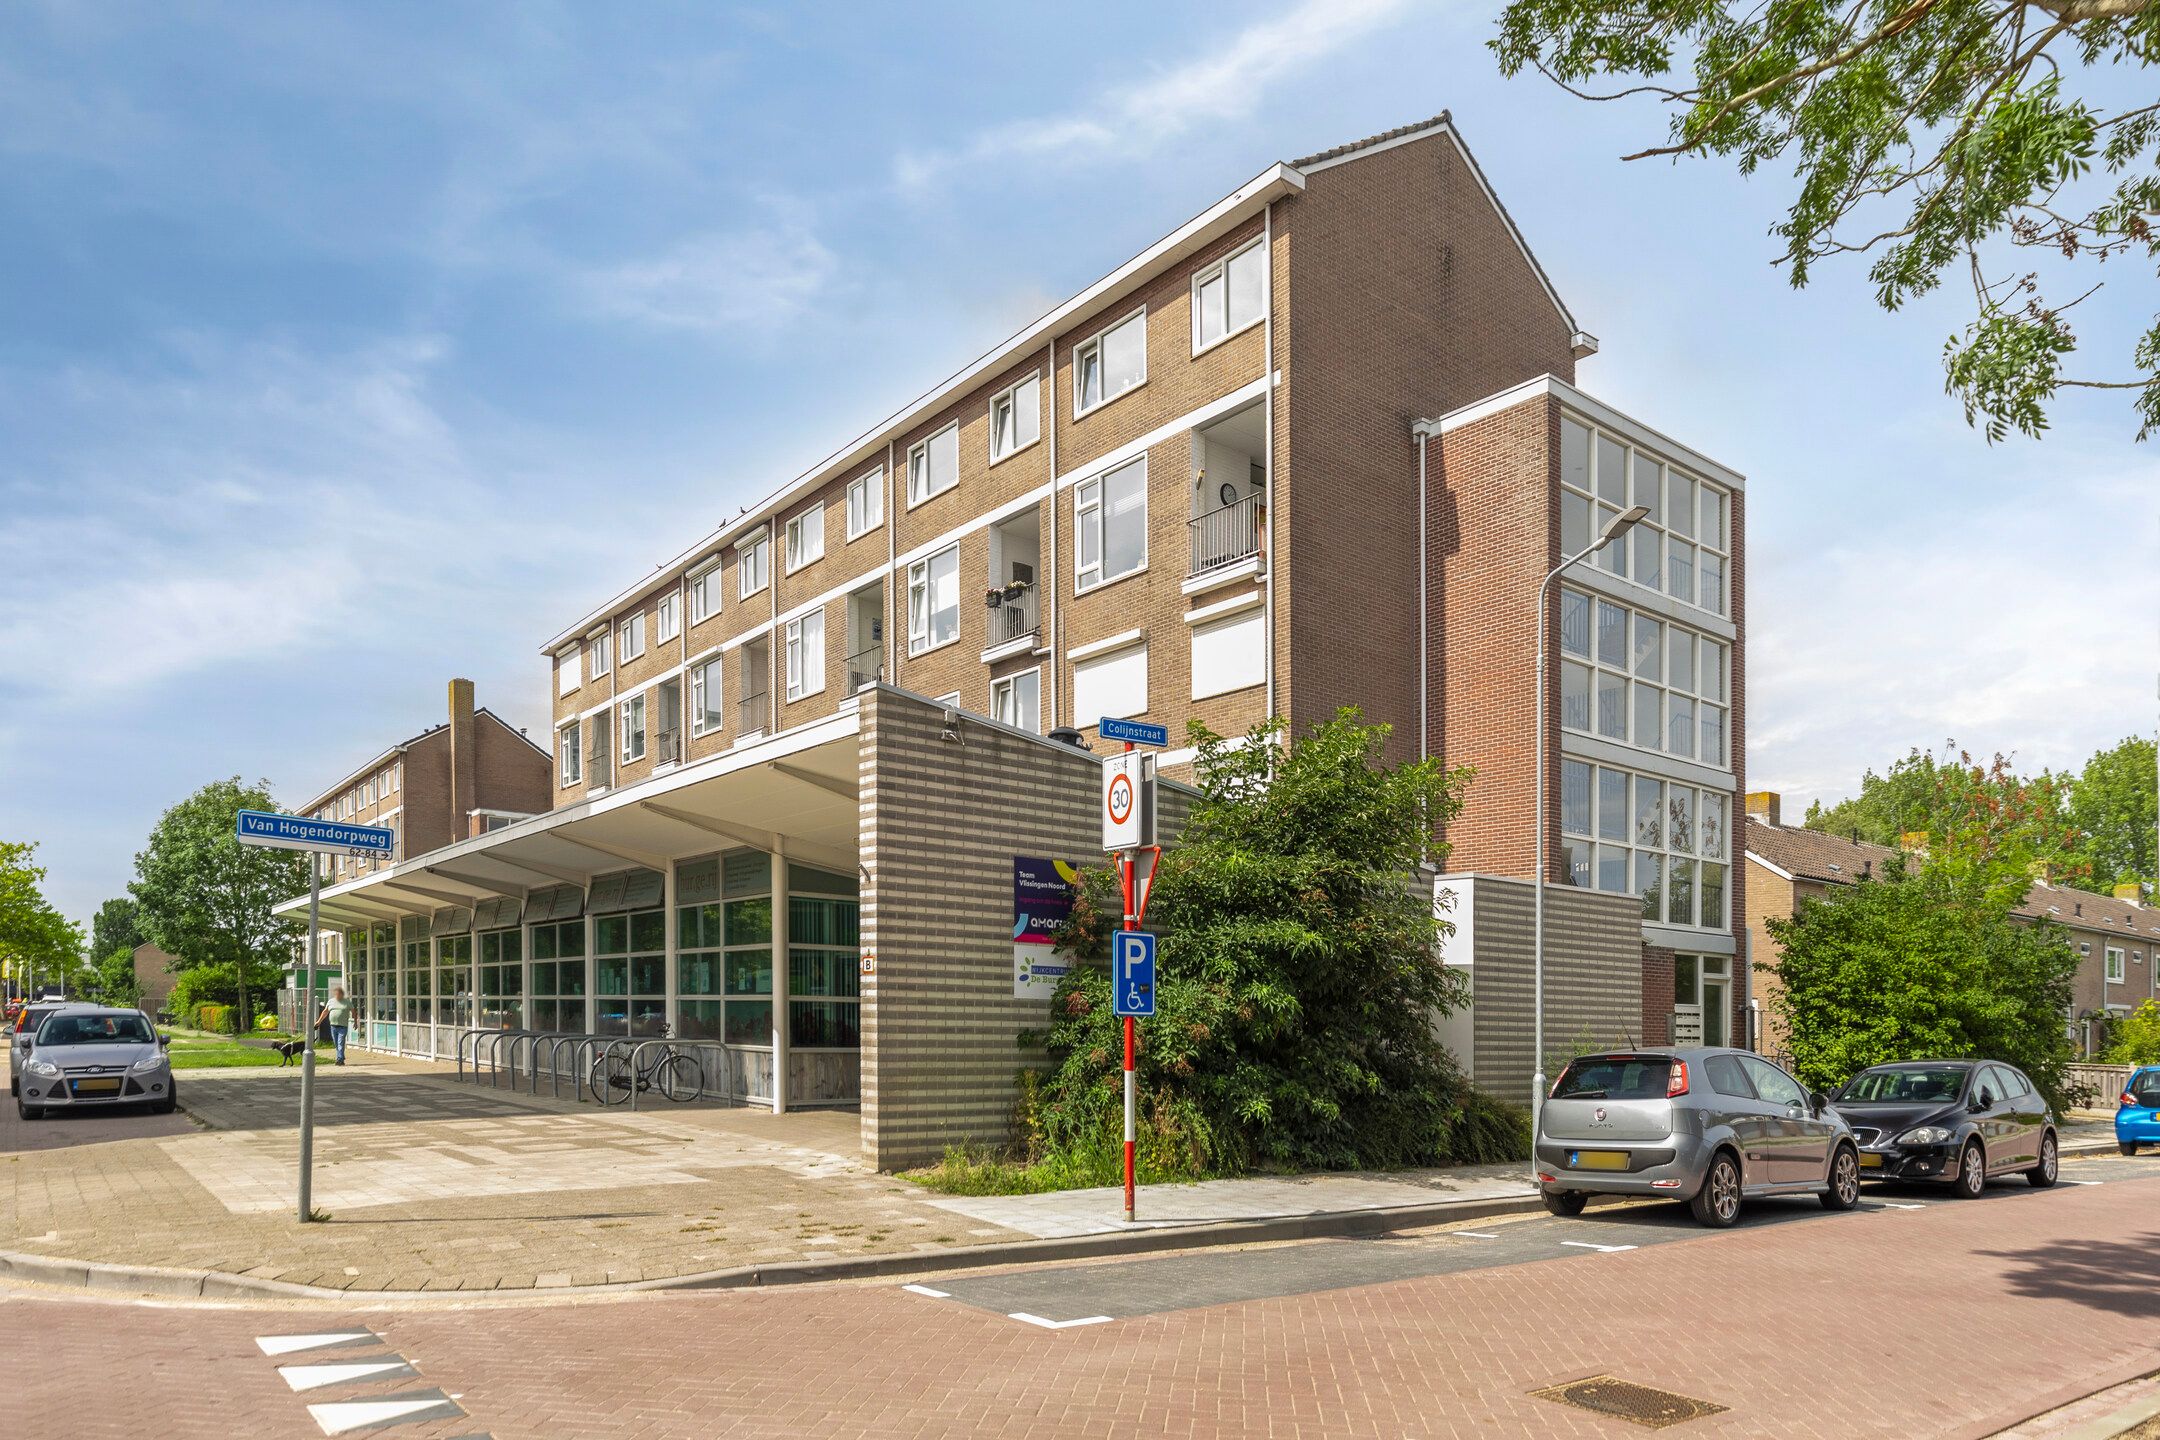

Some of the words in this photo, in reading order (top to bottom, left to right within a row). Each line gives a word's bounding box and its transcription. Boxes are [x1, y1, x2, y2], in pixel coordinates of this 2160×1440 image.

[1108, 723, 1161, 740] Colijnstraat
[1113, 788, 1129, 810] 30
[247, 817, 274, 832] Van
[279, 821, 386, 847] Hogendorpweg
[349, 848, 377, 858] 62-84
[1018, 880, 1047, 889] Vlissingen
[1125, 938, 1147, 979] P
[1031, 966, 1070, 975] WIJKCENTRU
